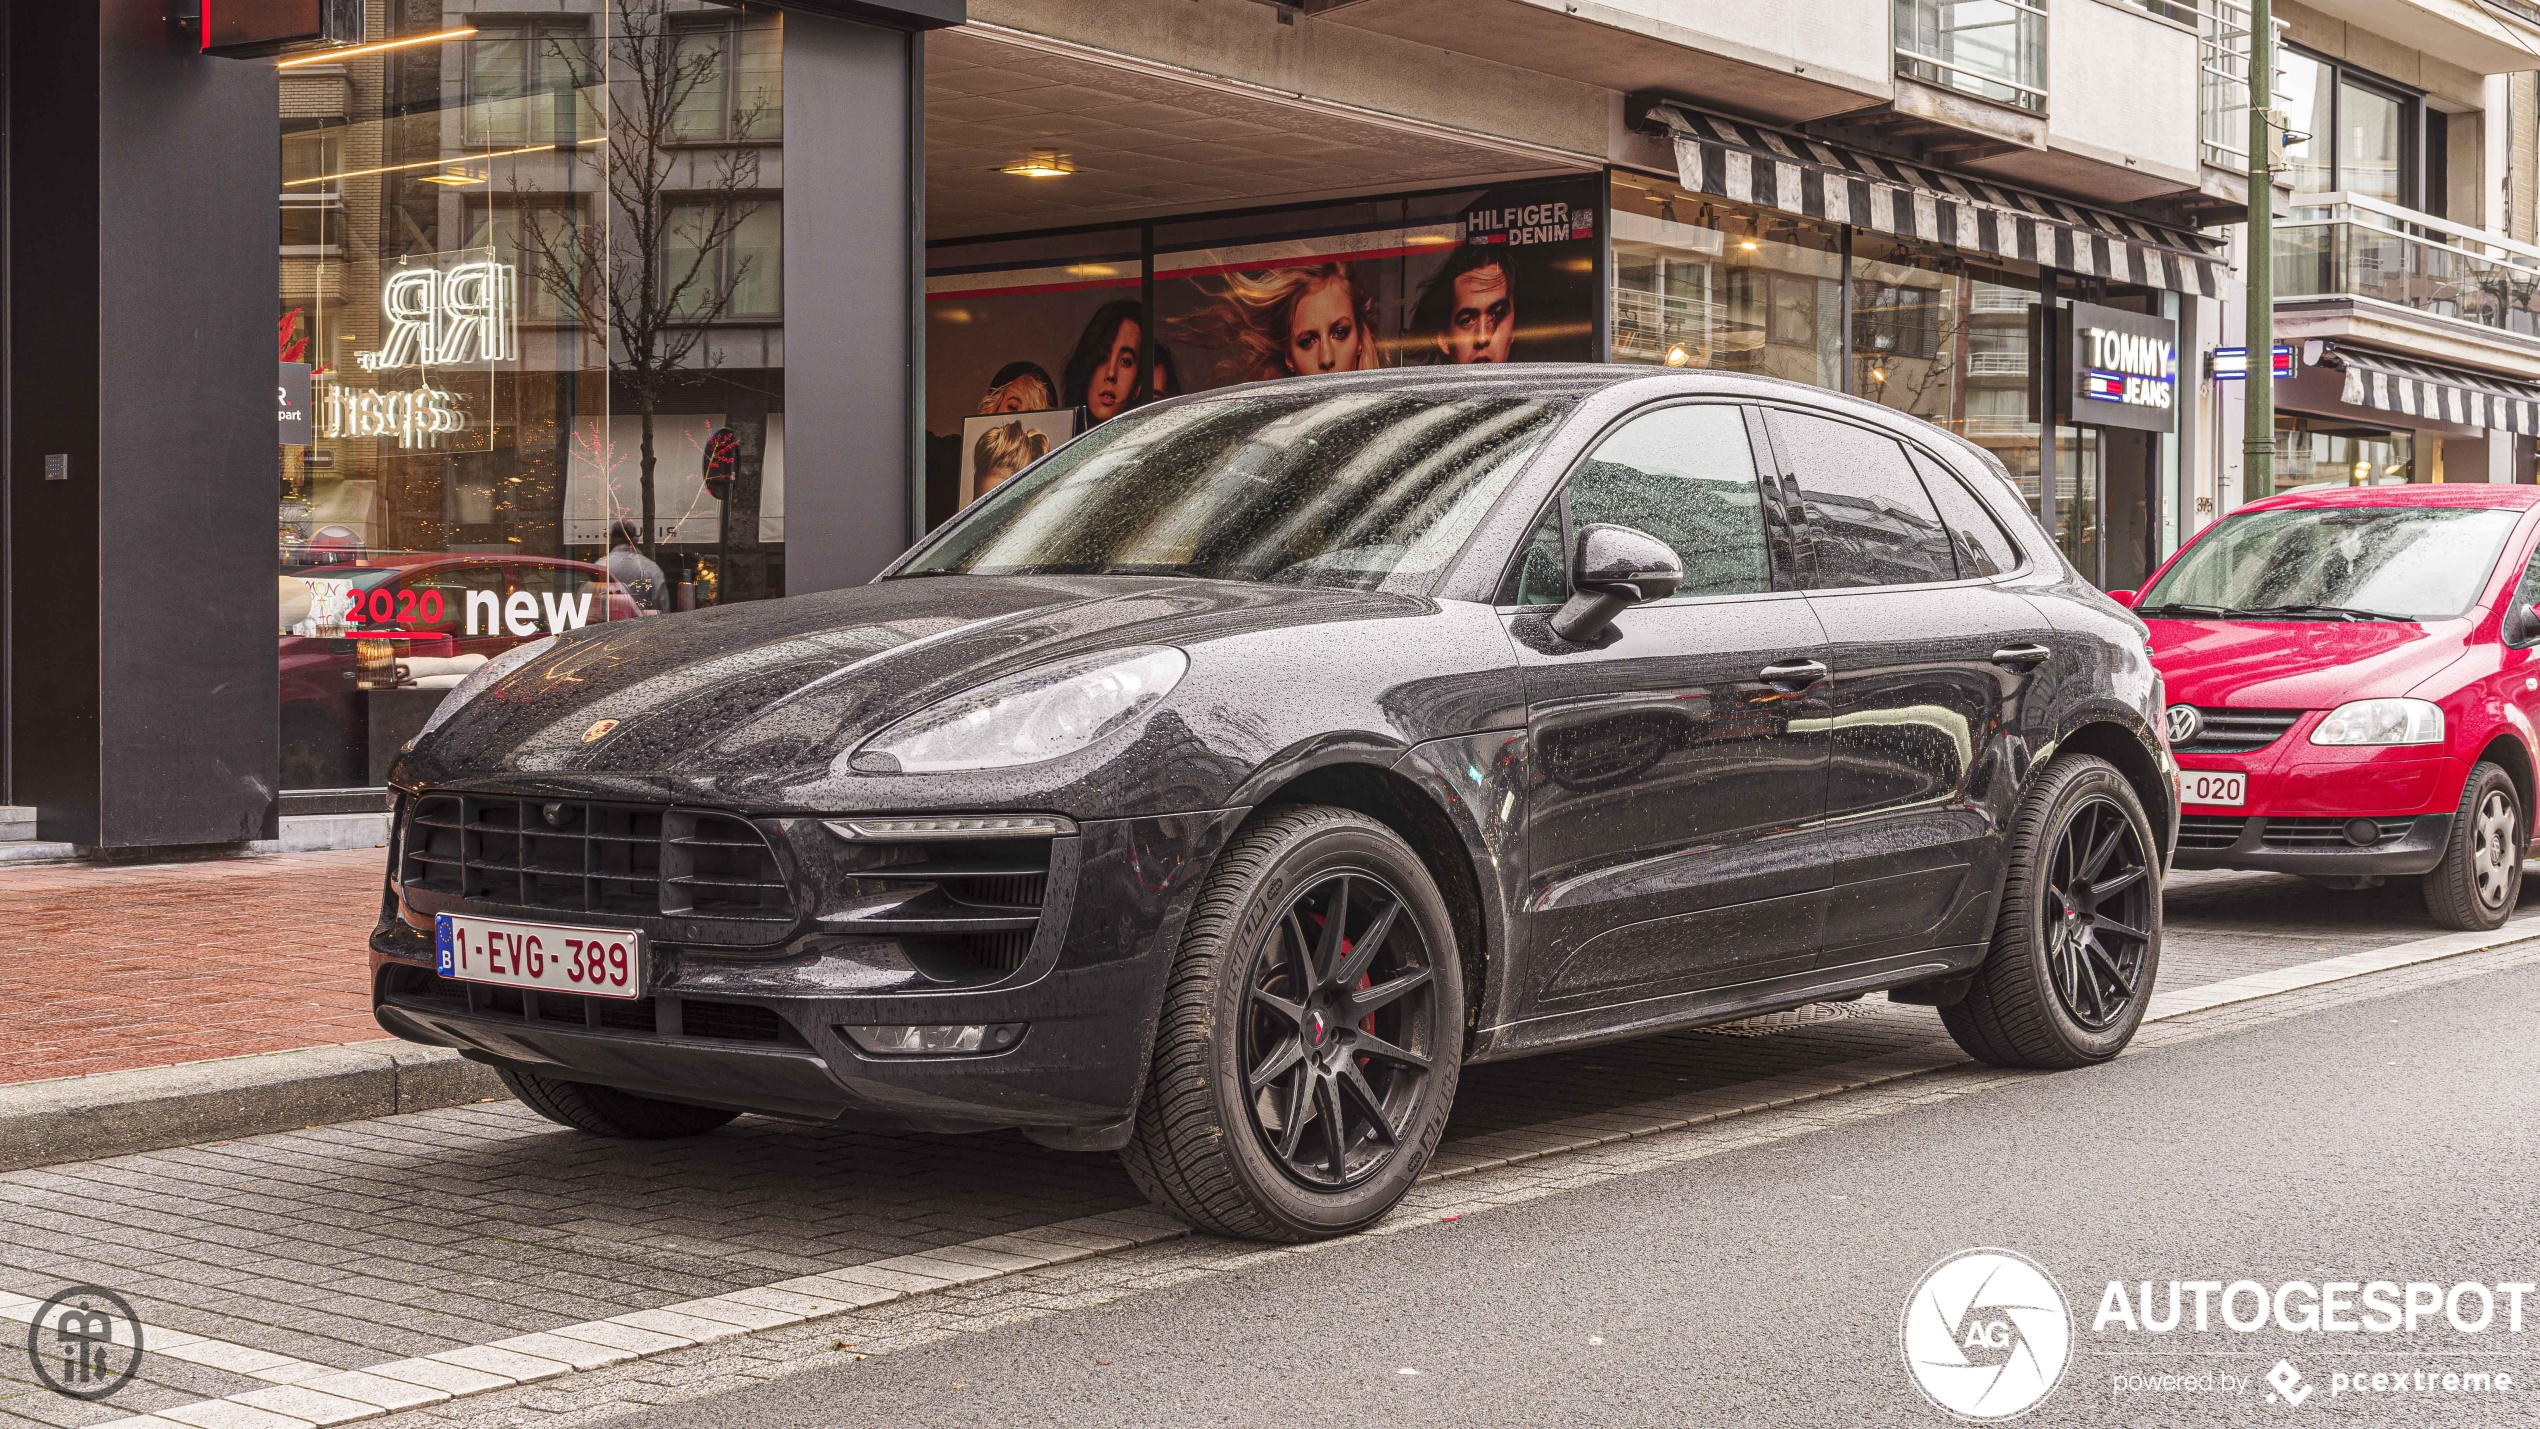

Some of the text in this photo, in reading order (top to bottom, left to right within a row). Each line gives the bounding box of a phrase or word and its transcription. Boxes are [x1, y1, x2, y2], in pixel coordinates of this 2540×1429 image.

[1469, 202, 1569, 232] HILFIGER
[1508, 223, 1570, 246] DENIM
[2088, 326, 2172, 379] TOMMY
[2122, 376, 2171, 409] JEANS
[346, 588, 445, 624] 2020
[466, 589, 593, 637] new
[442, 927, 628, 987] B 1-EVG-389
